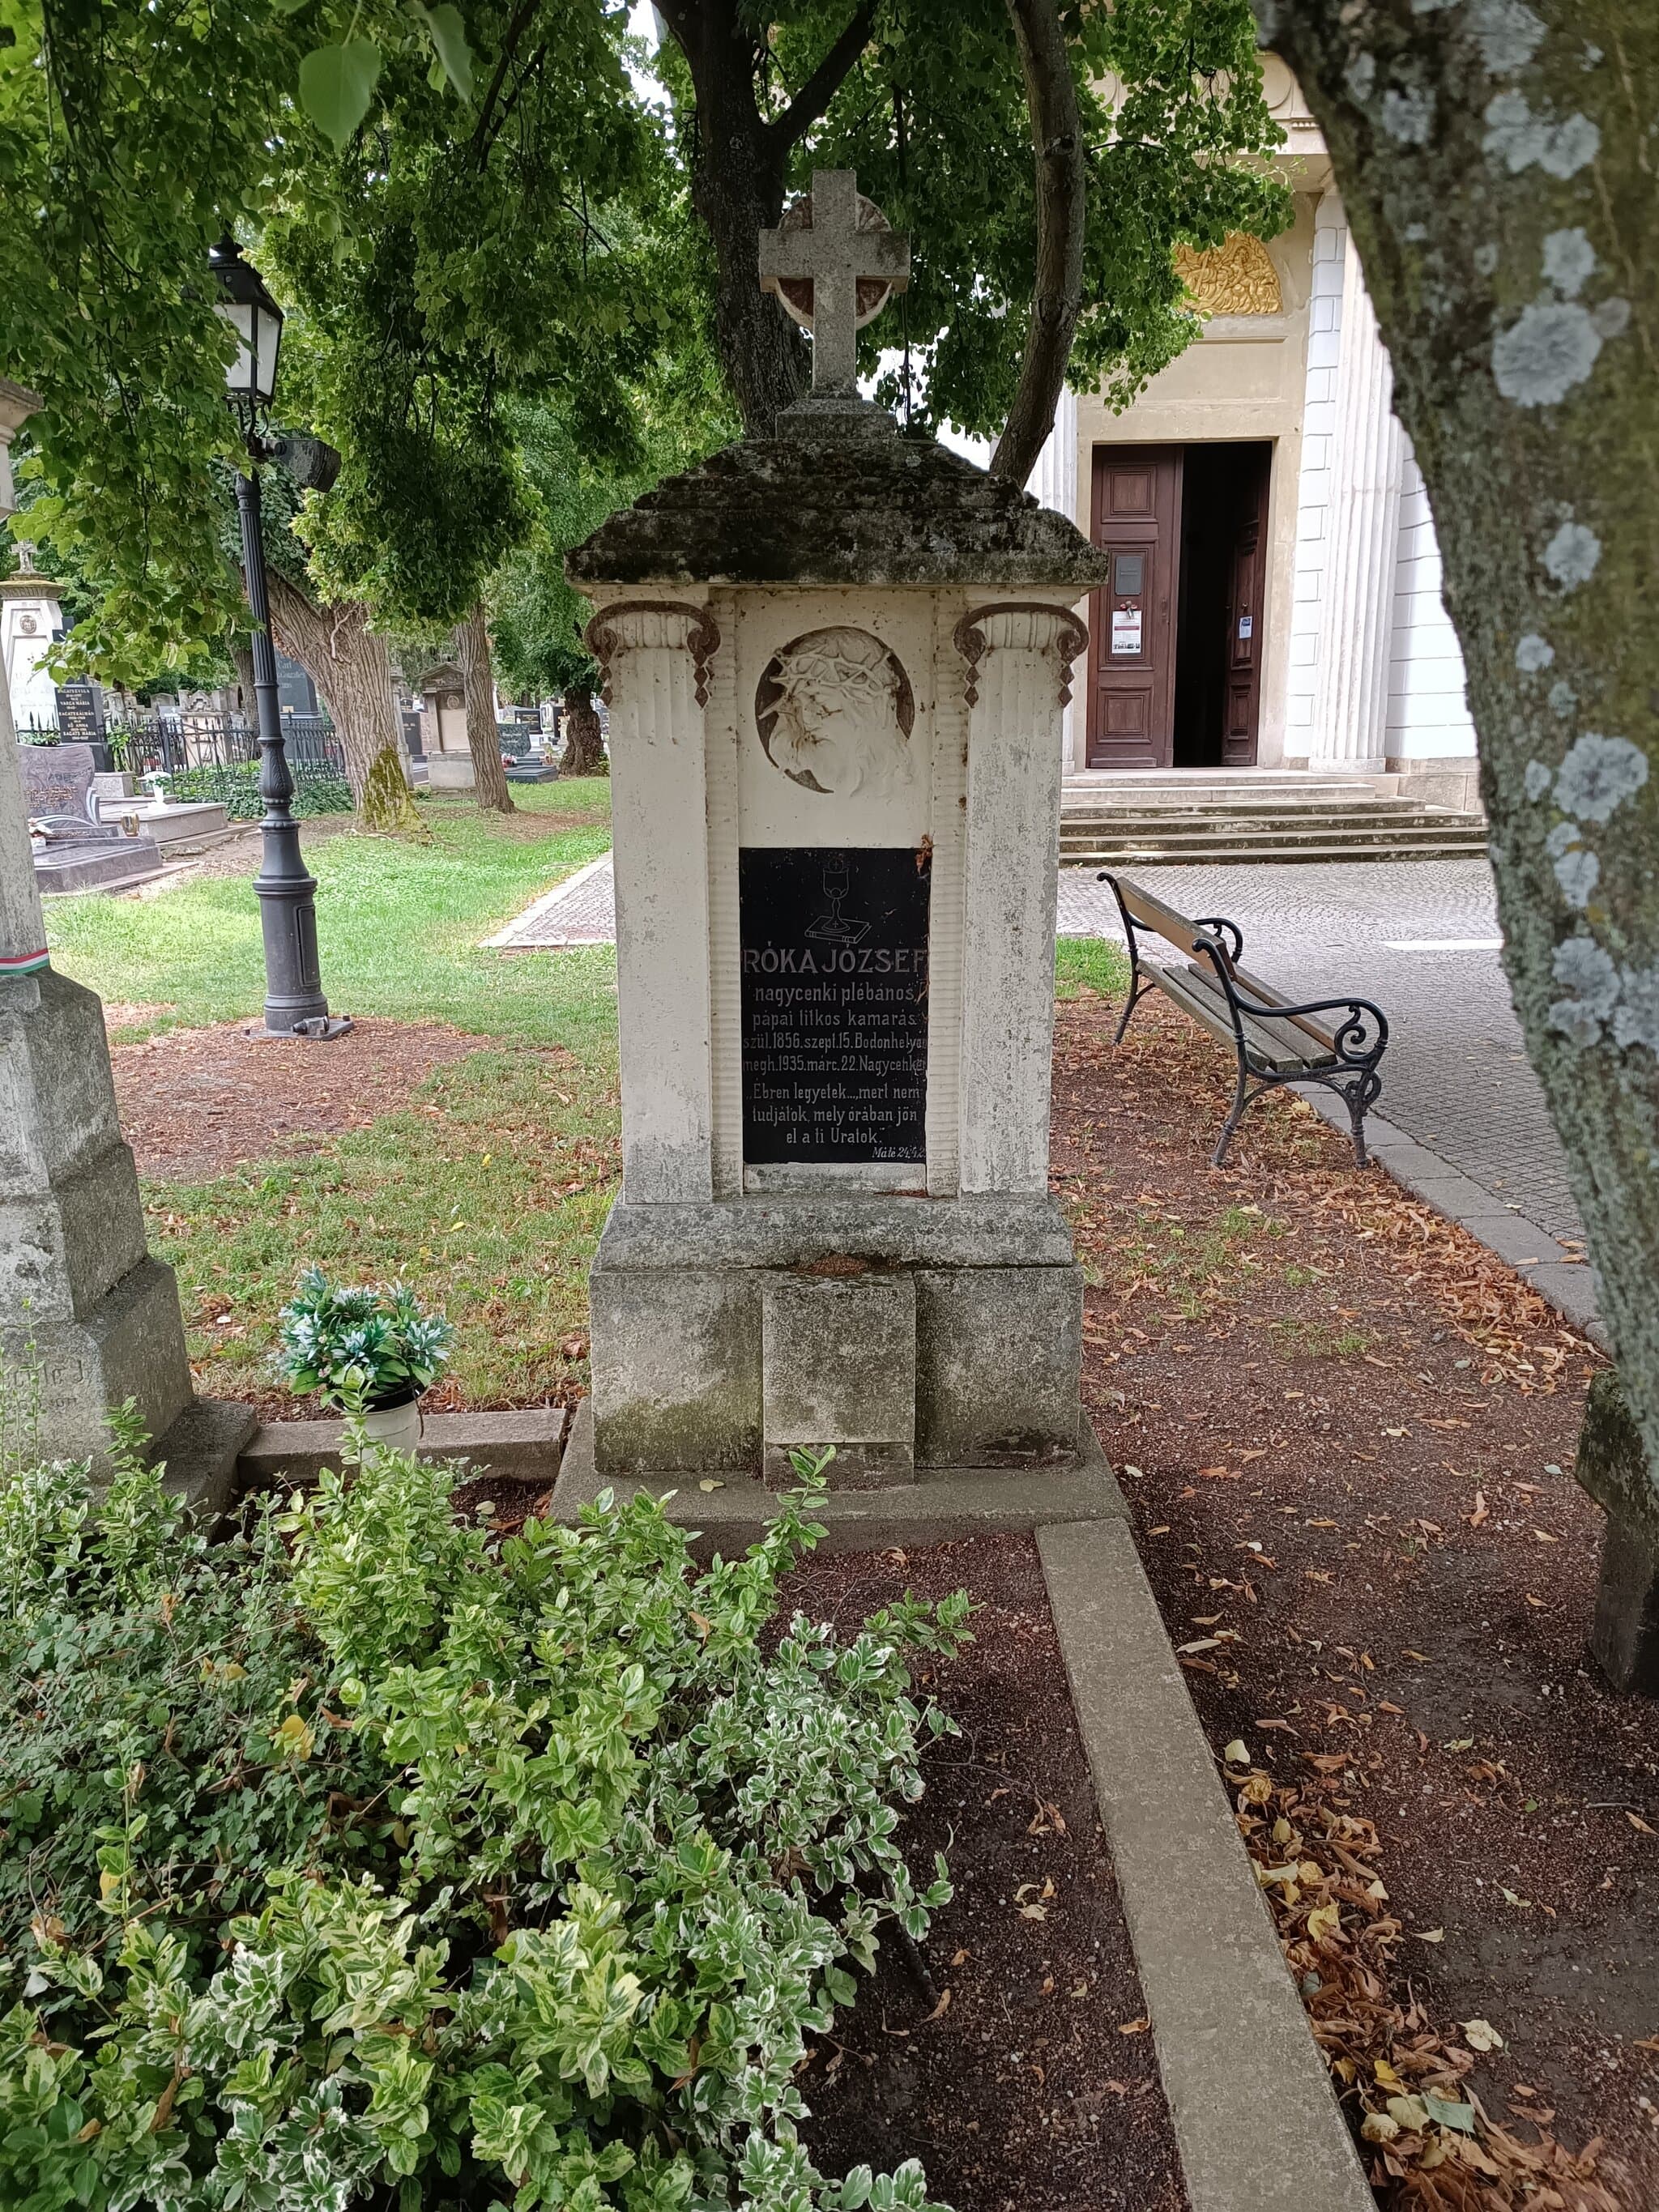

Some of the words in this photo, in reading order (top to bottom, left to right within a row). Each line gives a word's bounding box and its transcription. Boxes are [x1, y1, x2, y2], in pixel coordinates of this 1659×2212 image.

[744, 940, 818, 973] RÓKA
[821, 943, 928, 973] JÓZSEF
[756, 982, 837, 1007] nagycenki
[753, 1010, 793, 1031] pápai
[859, 1082, 888, 1099] mert
[893, 1088, 920, 1099] nem
[813, 1105, 845, 1127] mely
[848, 1104, 893, 1121] órában
[787, 1128, 797, 1143] el
[802, 1133, 810, 1143] a
[815, 1127, 825, 1143] ti
